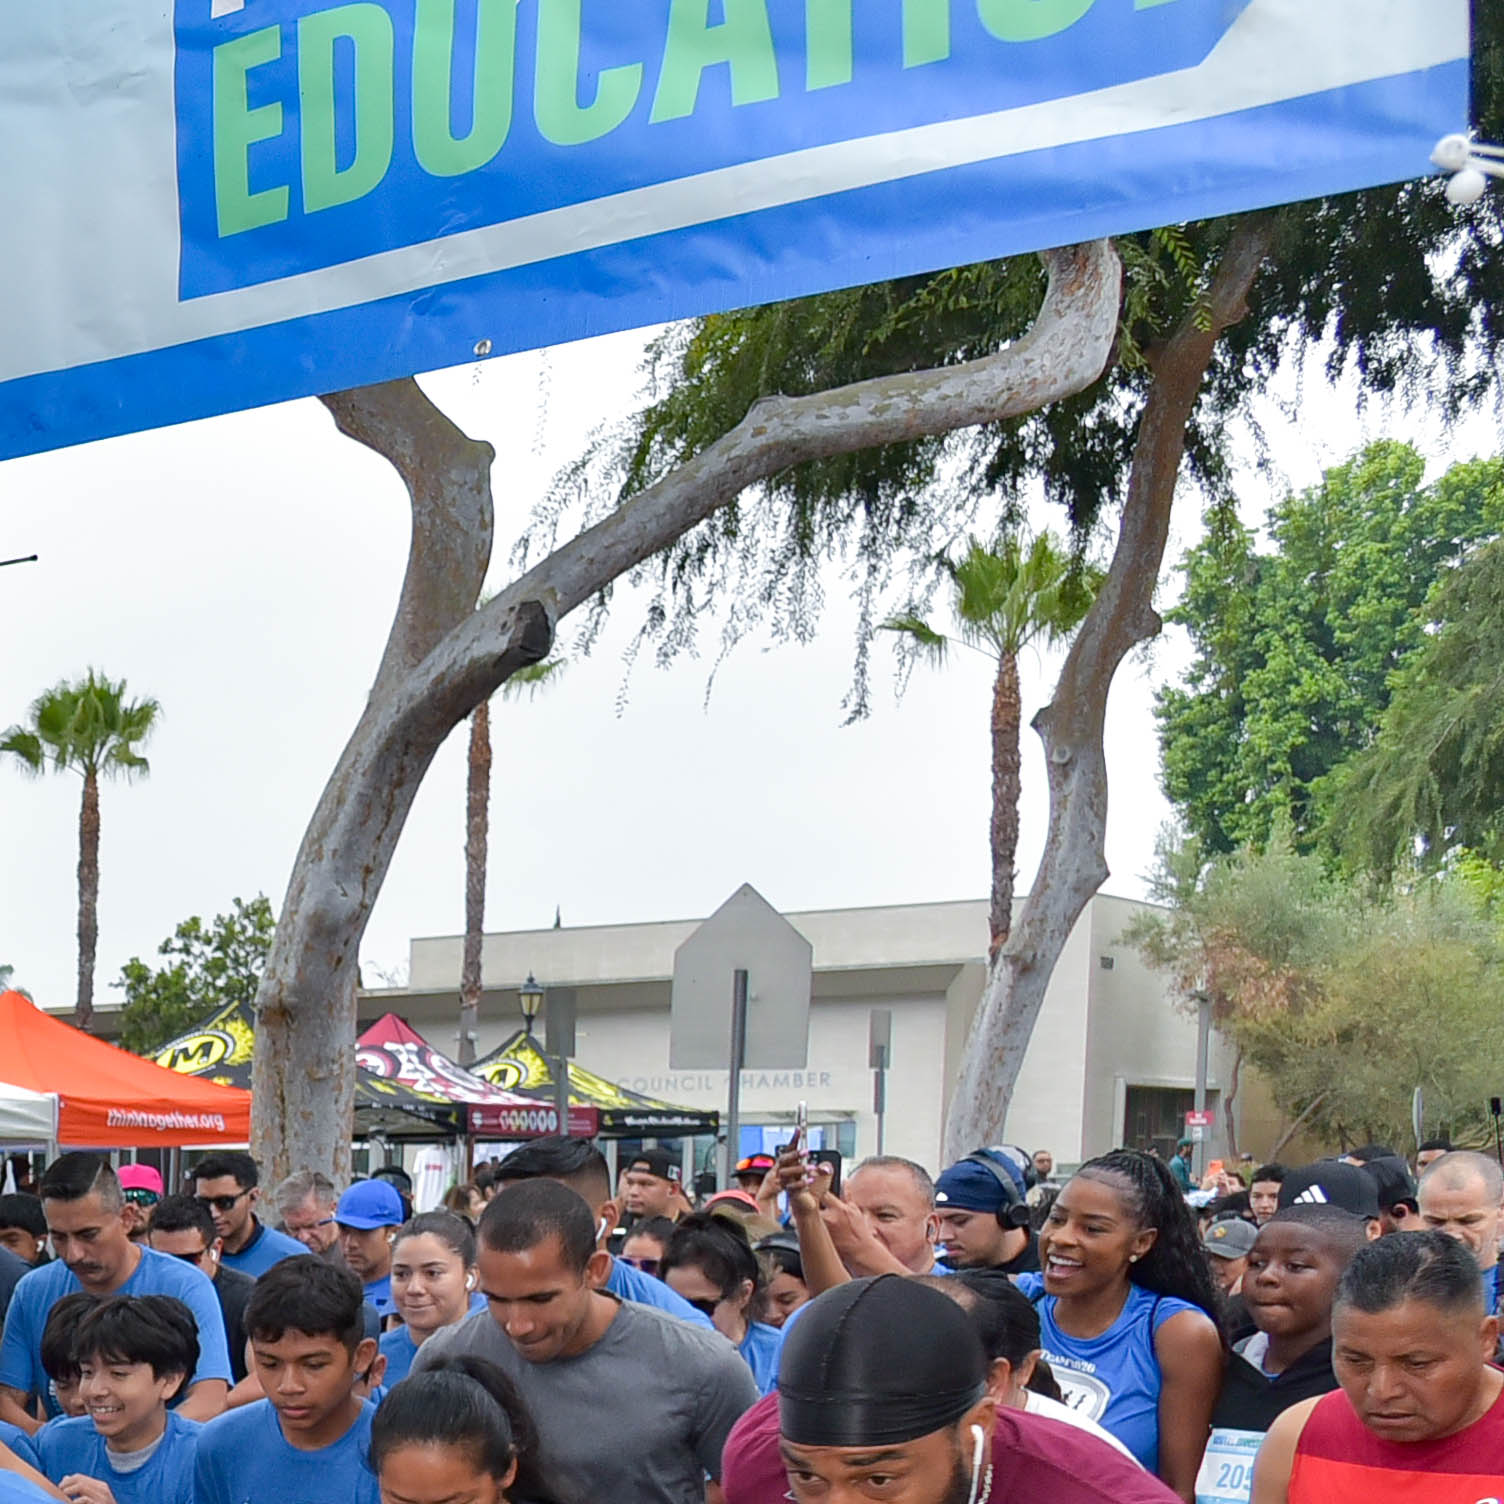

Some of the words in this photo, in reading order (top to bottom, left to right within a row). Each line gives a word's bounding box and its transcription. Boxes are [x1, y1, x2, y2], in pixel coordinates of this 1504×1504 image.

[213, 0, 1175, 238] EDUCA
[617, 1075, 713, 1094] COUNCIL
[106, 1108, 226, 1132] thinktogether.org
